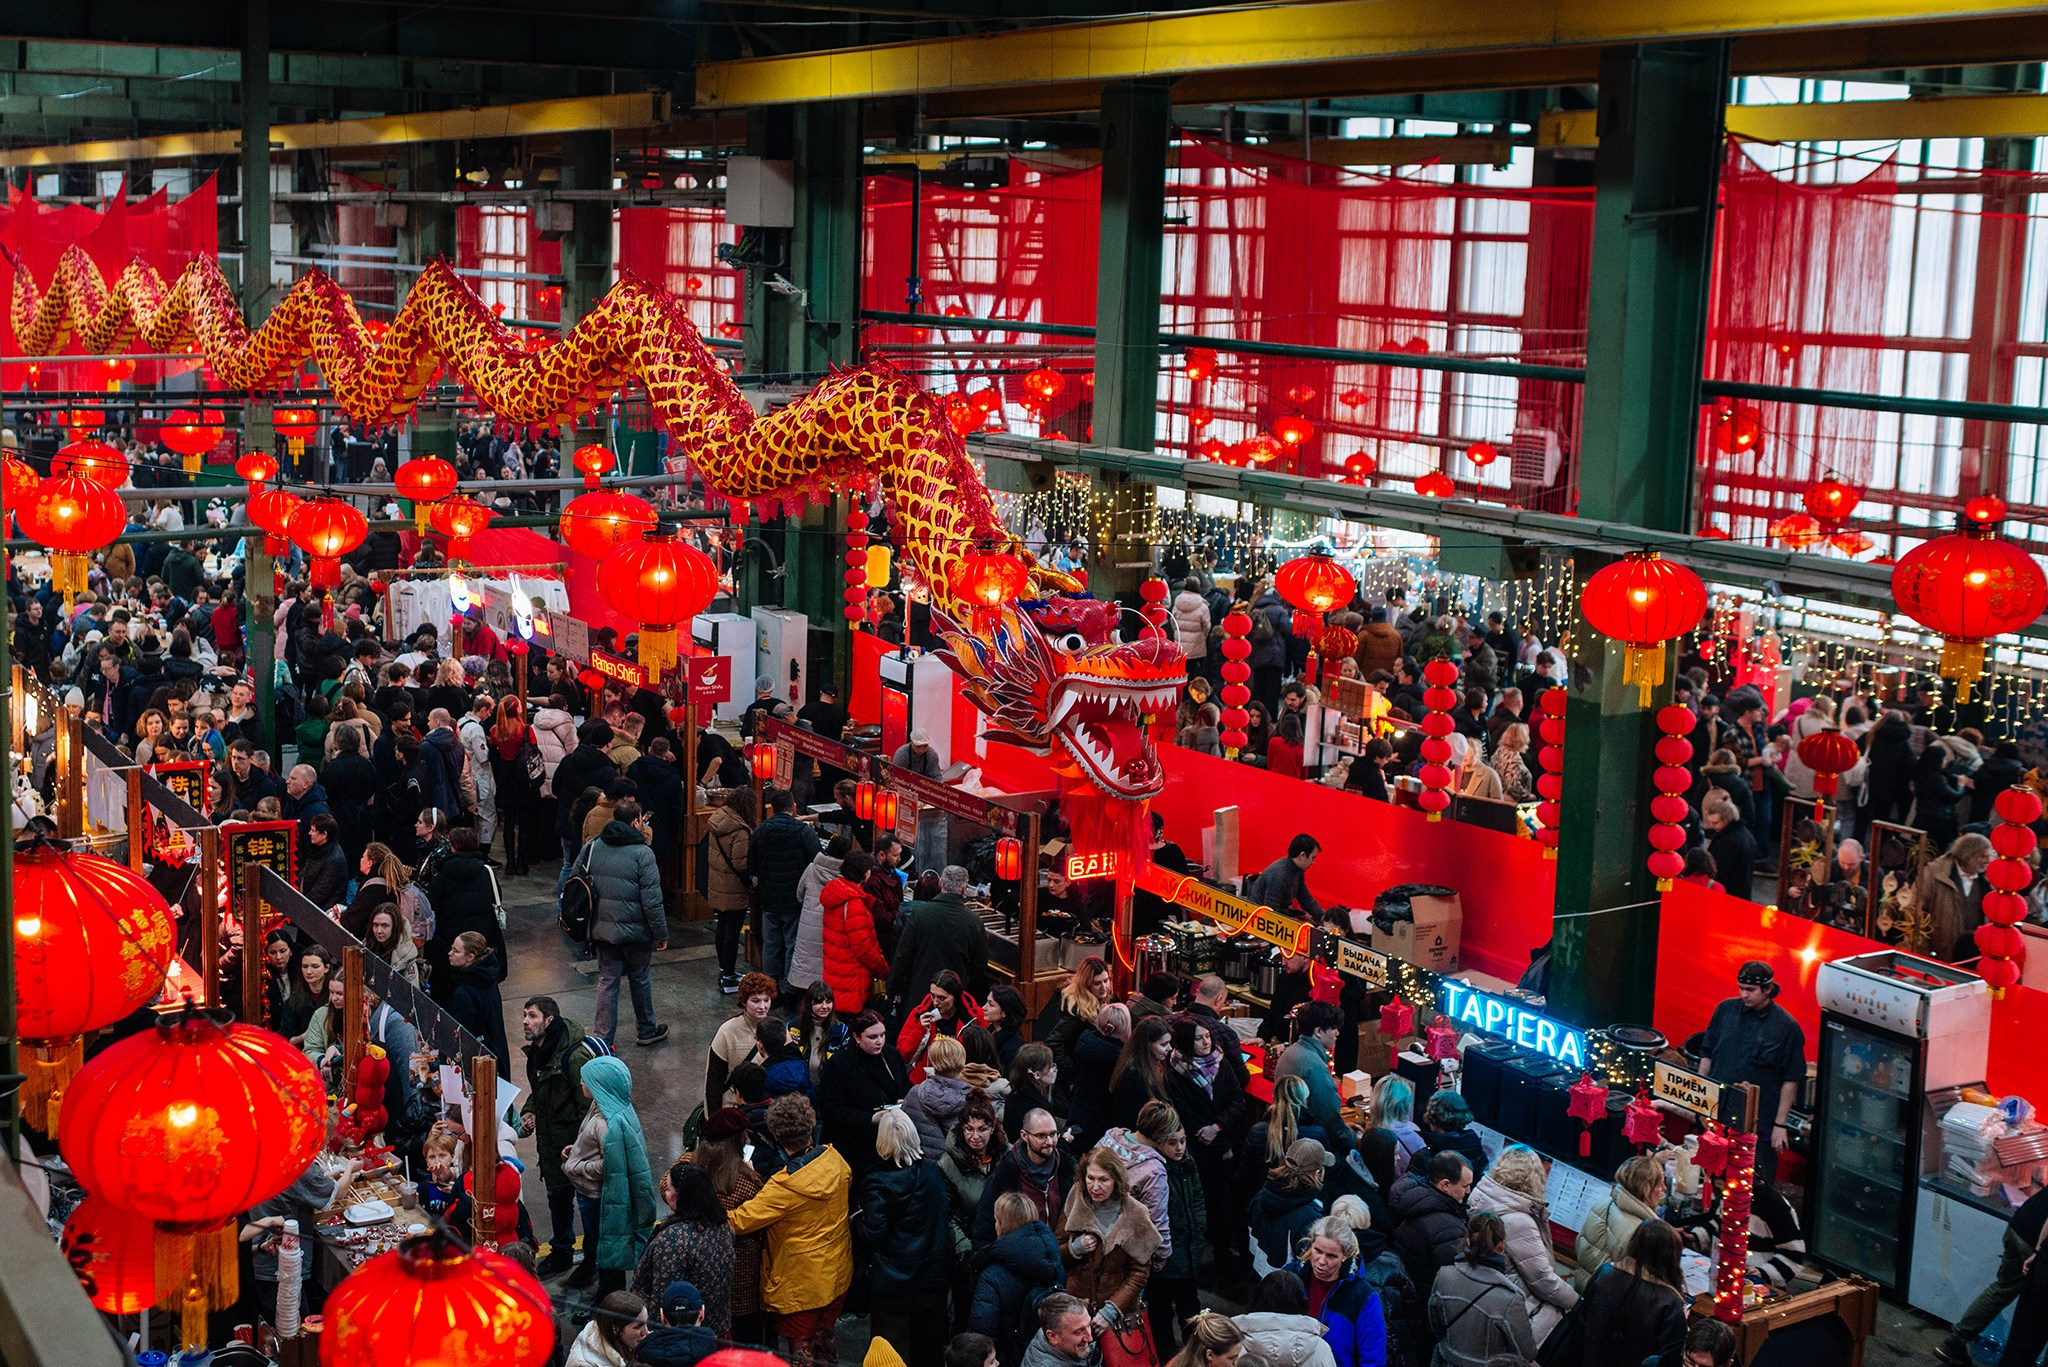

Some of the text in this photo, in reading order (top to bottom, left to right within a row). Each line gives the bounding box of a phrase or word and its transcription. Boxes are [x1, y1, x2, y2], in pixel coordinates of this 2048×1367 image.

[592, 652, 641, 686] Ramen Shifu
[1343, 947, 1381, 969] ВЫДАЧА
[1344, 958, 1380, 980] ЗАКАЗА
[1442, 981, 1582, 1068] TAPIERA
[1662, 1083, 1709, 1111] ЗАКАЗА
[1667, 1072, 1707, 1096] ПРИЁМ
